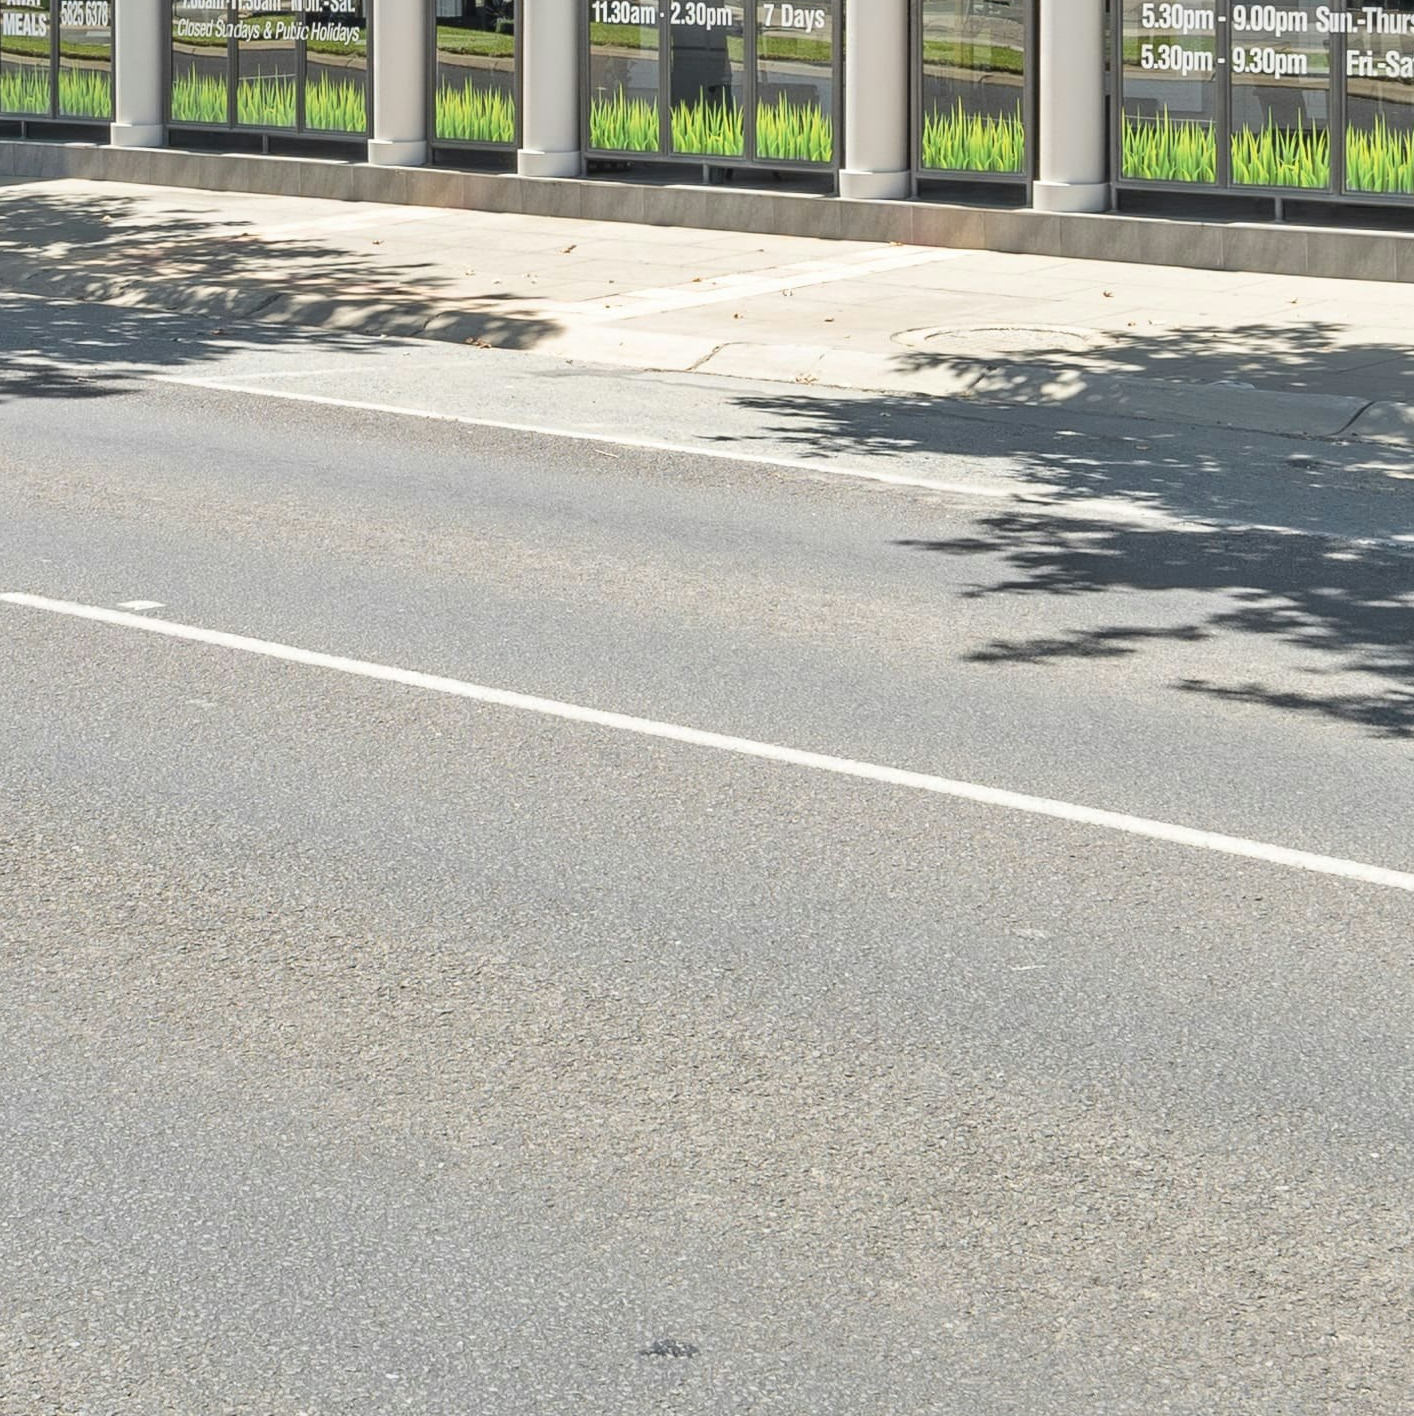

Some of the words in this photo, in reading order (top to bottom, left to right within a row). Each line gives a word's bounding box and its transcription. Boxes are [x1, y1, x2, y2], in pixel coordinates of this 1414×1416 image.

[2, 12, 47, 37] MEALS
[61, 0, 84, 26] 5825
[85, 0, 108, 27] 6378
[592, 0, 656, 25] 11.30am
[670, 2, 733, 31] 2.30pm
[763, 3, 775, 27] 7
[780, 4, 826, 33] Days
[1141, 2, 1214, 33] 5.30pm
[1233, 4, 1308, 37] 9.00pm
[177, 18, 214, 37] Closed
[215, 18, 260, 43] Sundays
[263, 21, 273, 40] &
[275, 21, 310, 41] Public
[310, 21, 360, 46] Holidays
[1140, 44, 1213, 76] 5.30pm
[1232, 47, 1308, 79] 9.30pm
